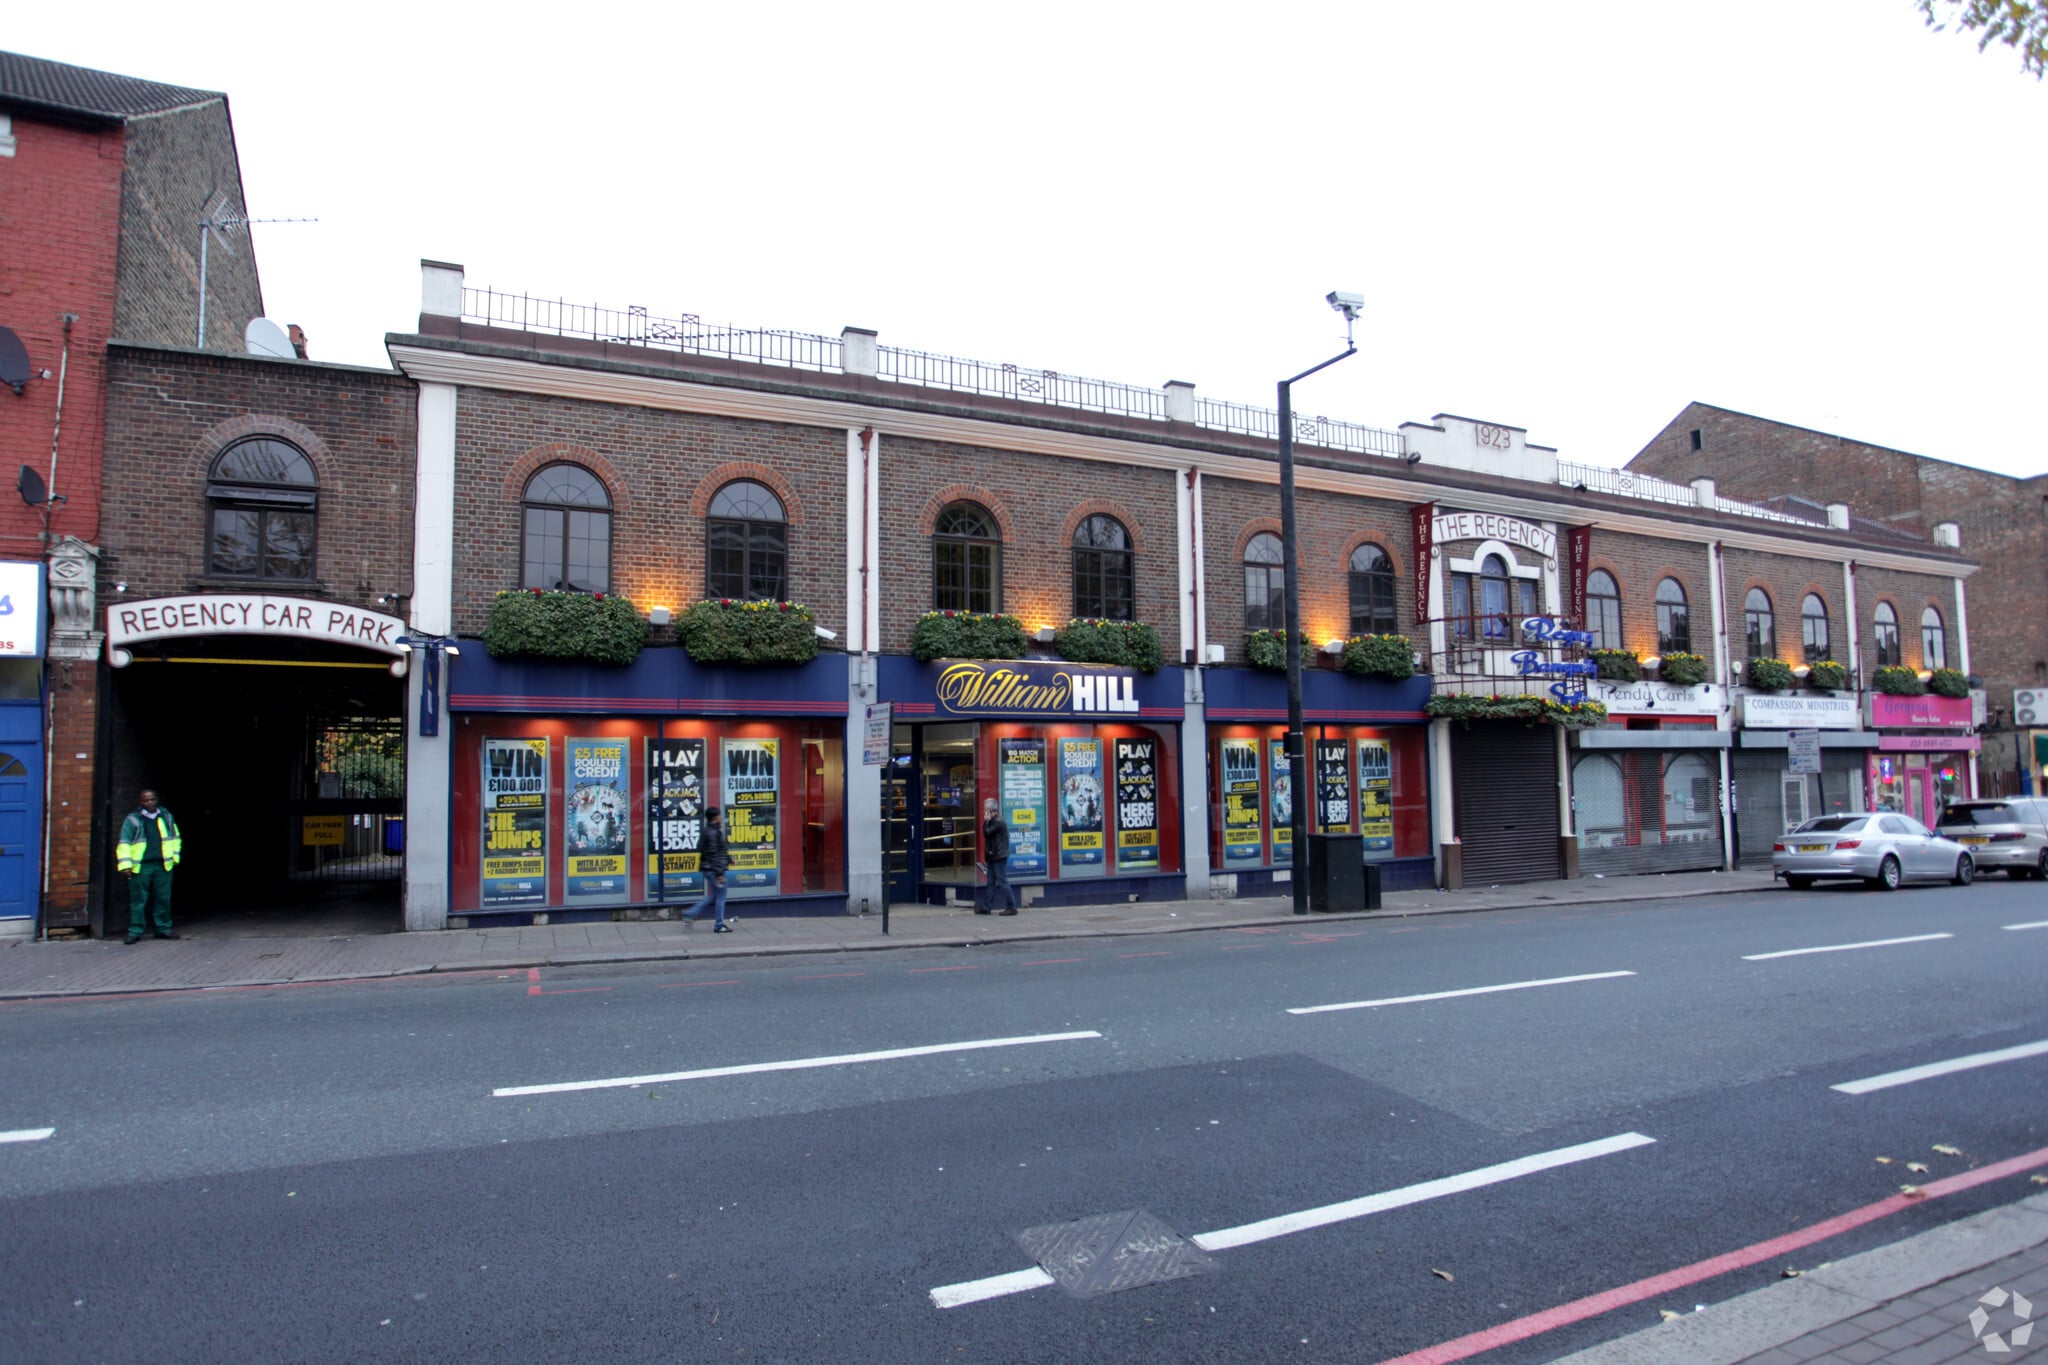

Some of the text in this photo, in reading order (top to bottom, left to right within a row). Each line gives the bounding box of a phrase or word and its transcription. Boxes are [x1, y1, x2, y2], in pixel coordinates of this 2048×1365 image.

[1474, 424, 1511, 449] 1923
[1434, 515, 1550, 552] THE REGENCY
[1575, 535, 1583, 562] THE
[1418, 514, 1427, 620] THE REGENCY
[121, 603, 395, 645] REGENCY CAR PARK
[936, 663, 1139, 714] William HILL
[1597, 686, 1696, 703] Trendy Curls
[1751, 699, 1850, 711] COMPASSION MINISTRIES
[575, 747, 621, 759] £5 FREE
[1078, 742, 1097, 752] FREE
[1119, 744, 1152, 759] PLAY
[488, 749, 542, 778] WIN
[575, 758, 621, 767] ROULETTE
[728, 750, 774, 777] WIN
[1008, 755, 1039, 763] ACTION
[1064, 759, 1097, 768] CREDIT
[1225, 747, 1257, 769] WIN
[1361, 747, 1388, 767] WIN
[574, 766, 621, 778] CREDIT
[1119, 774, 1154, 785] BLACKJACK
[1226, 795, 1243, 810] THE
[1363, 791, 1377, 805] THE
[728, 808, 752, 826] THE
[1120, 802, 1155, 817] HERE
[1226, 808, 1259, 824] JUMPS
[1363, 803, 1390, 817] JUMPS
[488, 812, 516, 831] THE
[1121, 816, 1154, 828] TODAY
[487, 829, 542, 850] JUMPS
[727, 825, 774, 843] JUMPS
